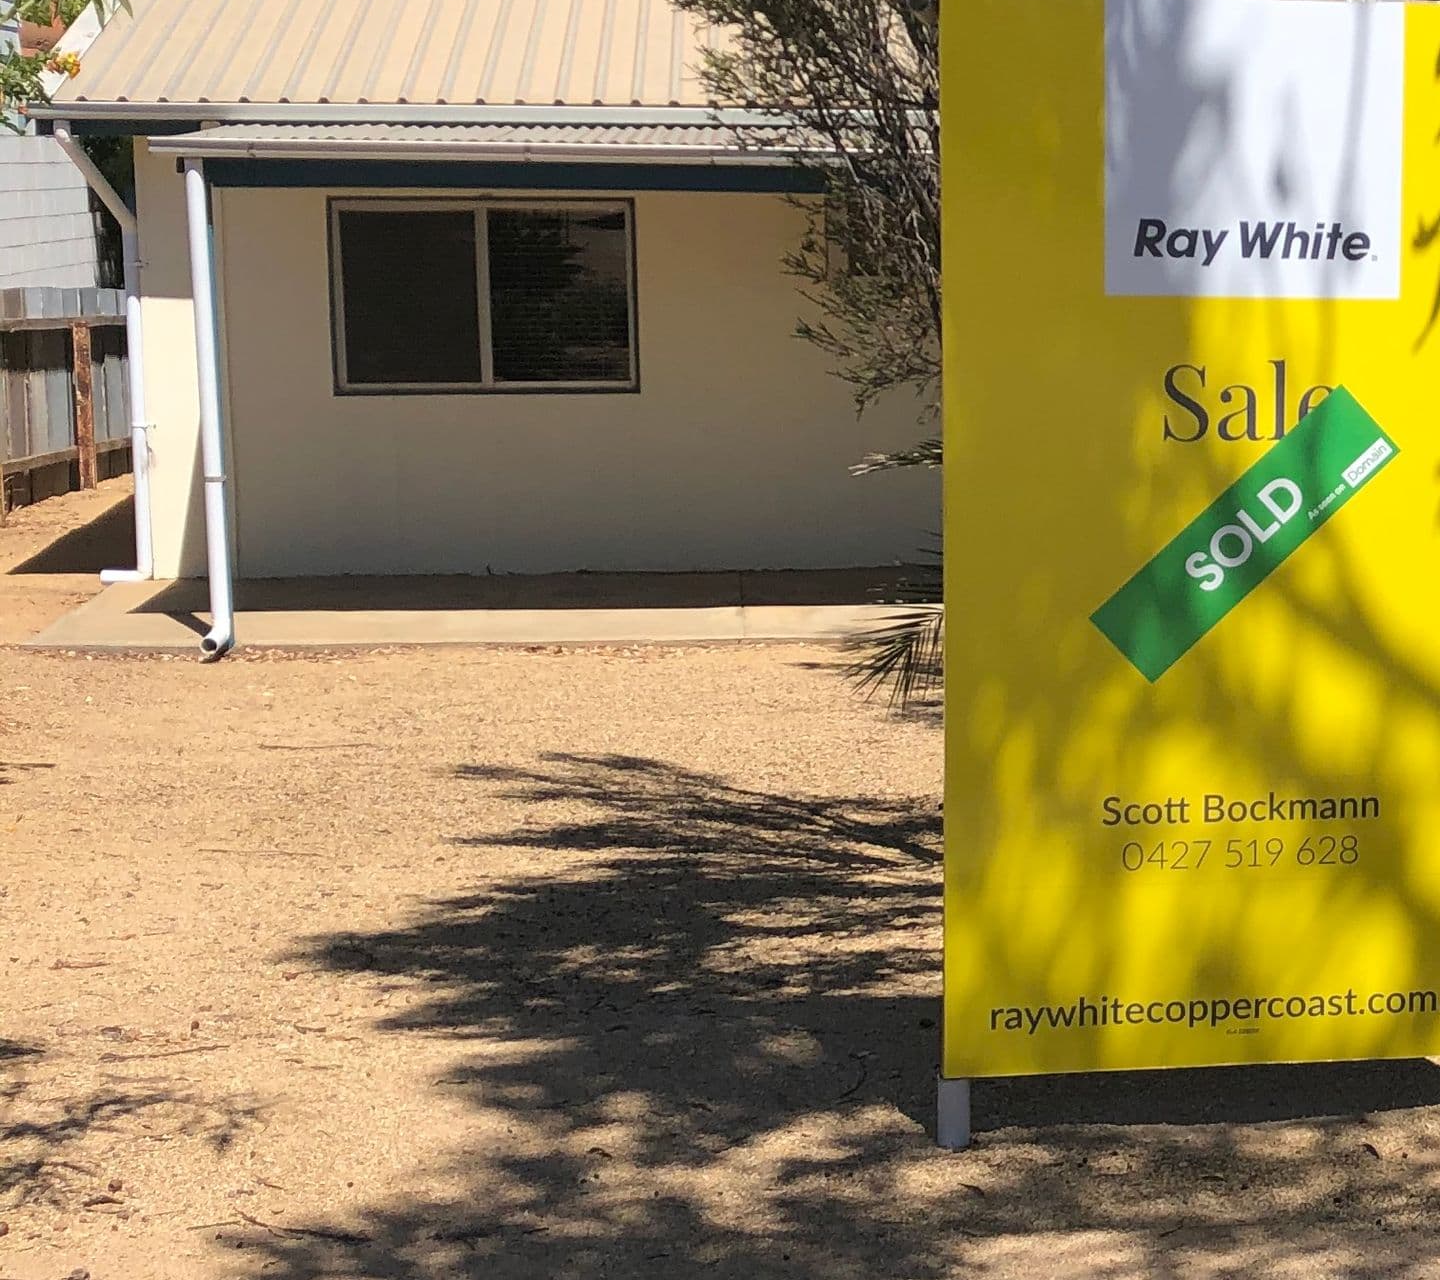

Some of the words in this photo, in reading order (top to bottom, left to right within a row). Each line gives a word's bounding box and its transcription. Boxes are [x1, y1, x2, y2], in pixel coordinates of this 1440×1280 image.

[1134, 218, 1229, 267] Ray
[1239, 221, 1371, 261] White
[1347, 445, 1387, 482] Domain
[1185, 477, 1304, 591] SOLD
[1102, 795, 1191, 826] Scott
[1203, 792, 1380, 823] Bockmann
[1121, 840, 1212, 871] 0427
[1225, 837, 1284, 868] 519
[1296, 835, 1359, 866] 628
